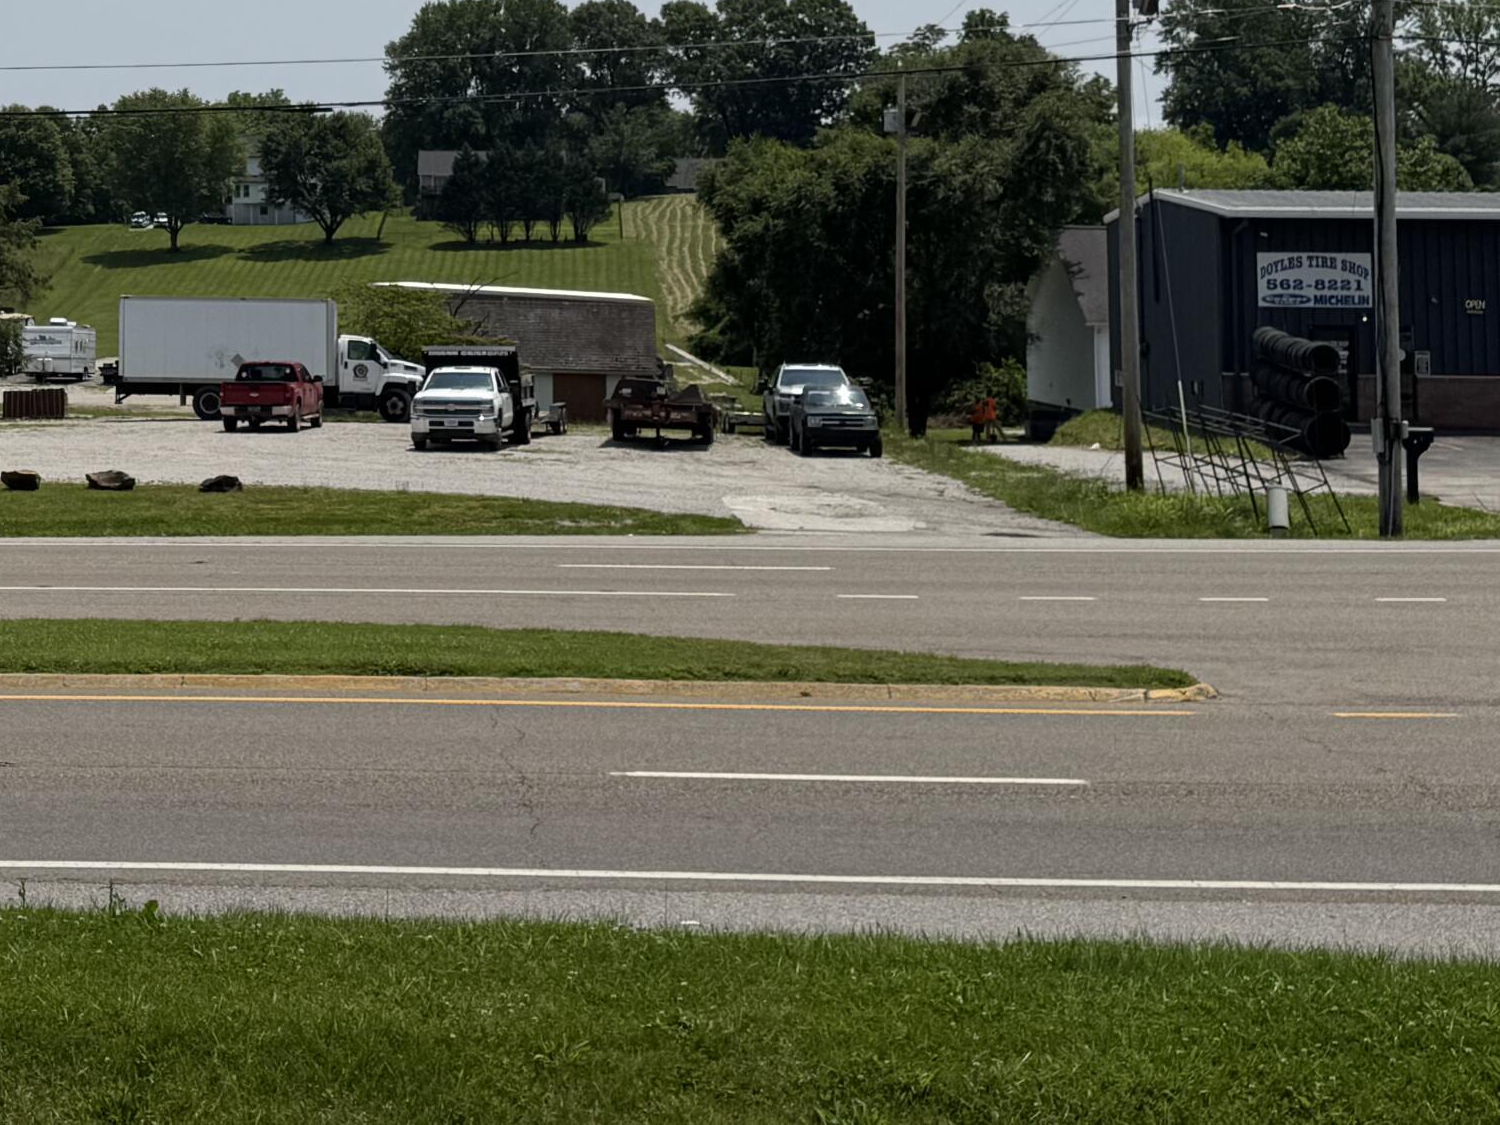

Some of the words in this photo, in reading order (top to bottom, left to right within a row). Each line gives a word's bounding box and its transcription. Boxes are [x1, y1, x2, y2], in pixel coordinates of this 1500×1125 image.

[1260, 256, 1303, 280] DOYLES
[1306, 256, 1338, 270] TIRE
[1341, 259, 1370, 281] SHOP
[1266, 279, 1365, 291] 562-8221
[1313, 295, 1370, 306] MICHELIN
